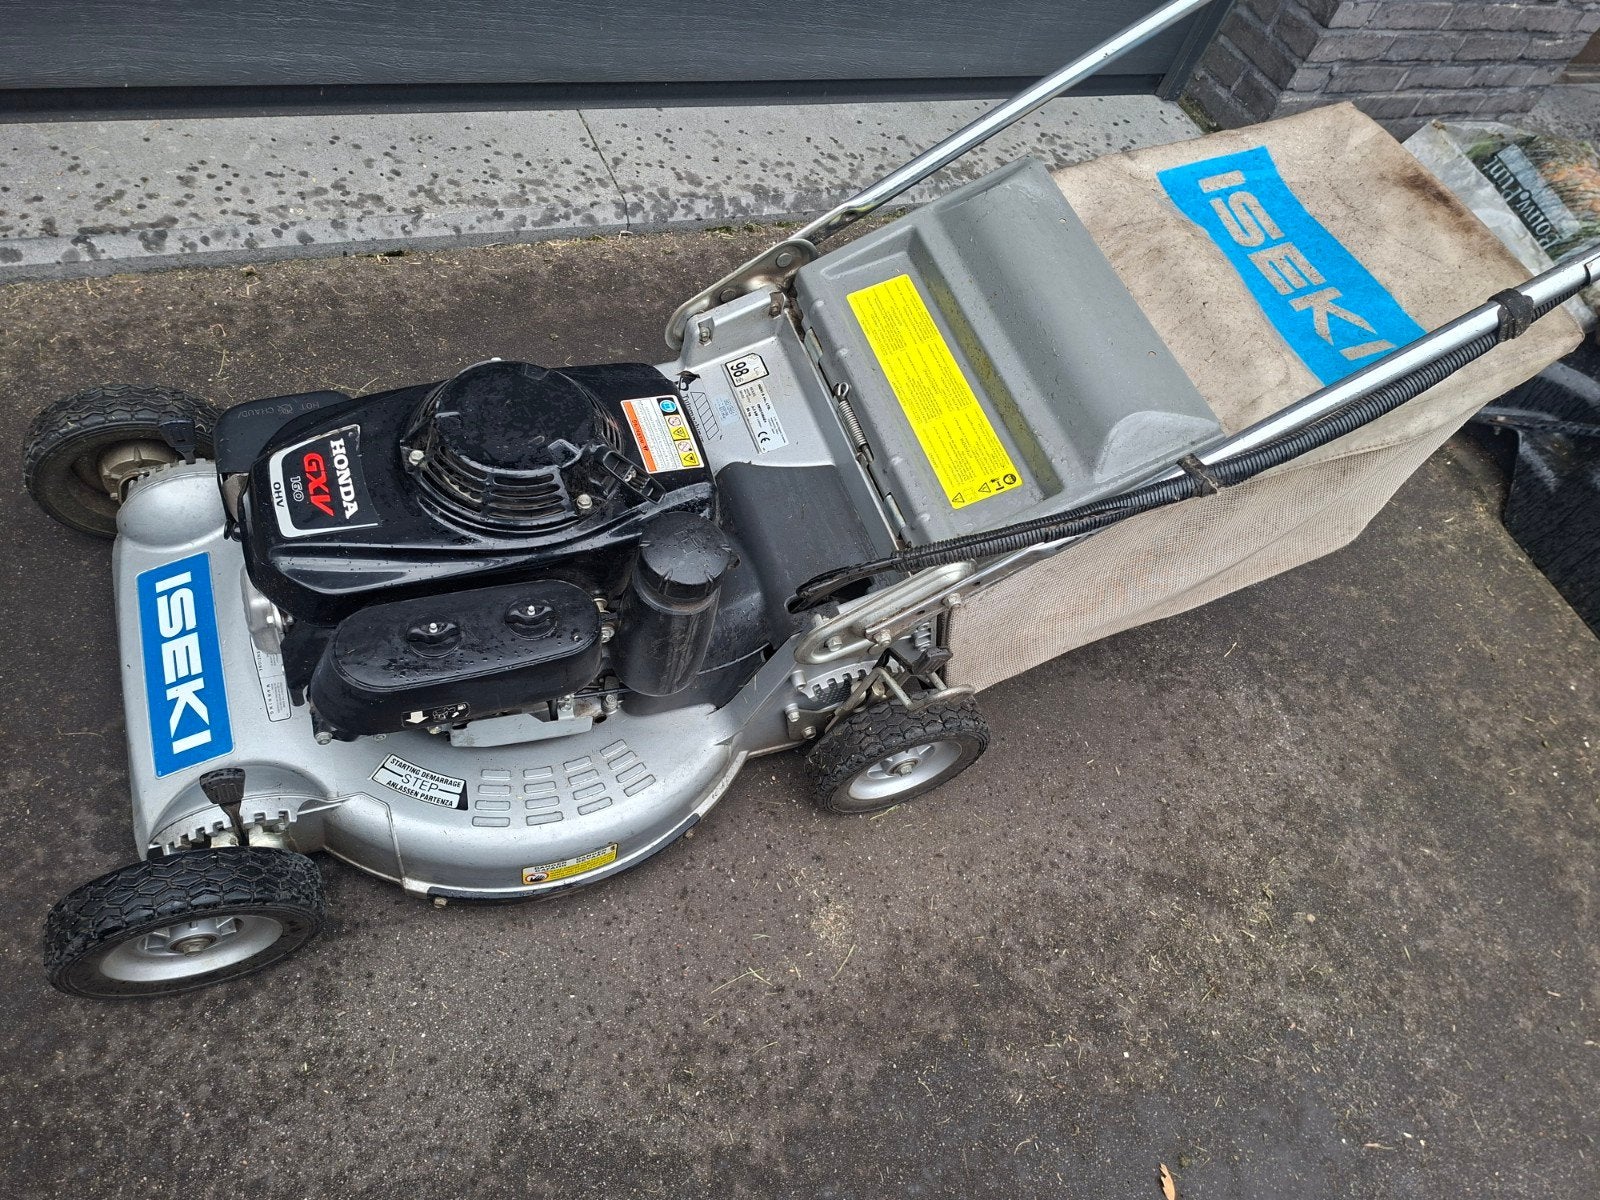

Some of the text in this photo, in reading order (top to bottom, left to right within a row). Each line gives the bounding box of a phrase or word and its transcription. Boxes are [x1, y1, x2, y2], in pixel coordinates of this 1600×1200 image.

[1198, 171, 1396, 361] ISEKI
[730, 361, 750, 378] 98
[290, 475, 304, 501] 160
[303, 452, 335, 516] GXV
[330, 438, 358, 519] HONDA
[273, 482, 284, 508] OHV
[155, 571, 212, 755] ISEKI
[390, 758, 462, 788] STARTING DEMARRAGE
[401, 773, 439, 792] STEP
[386, 780, 453, 807] ANLASSEN PARTENZA
